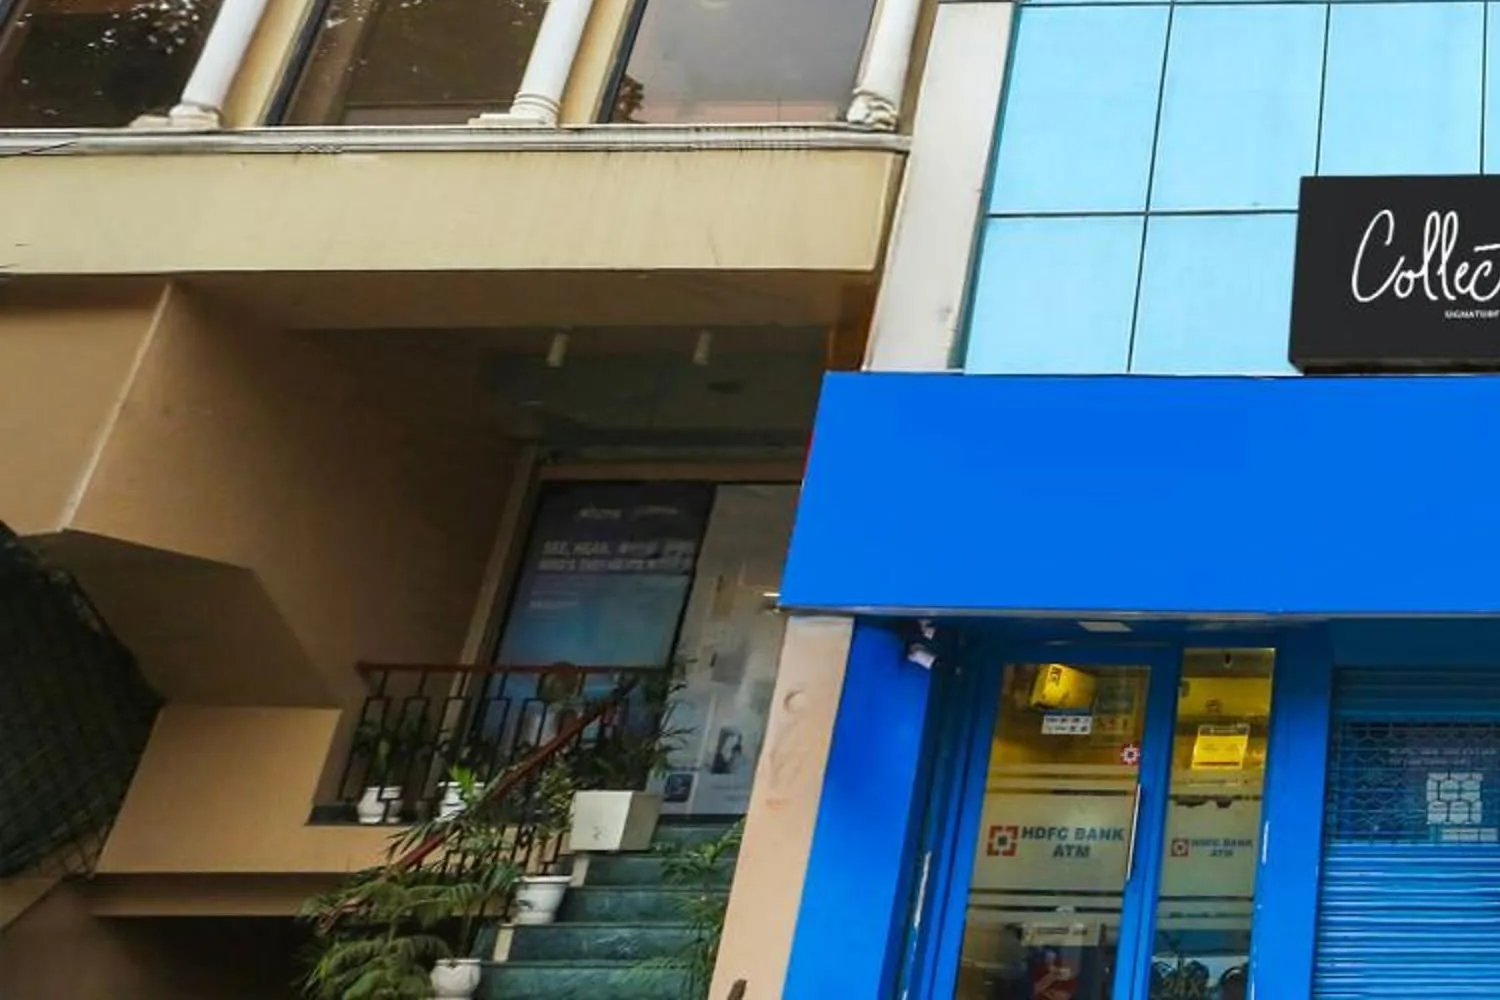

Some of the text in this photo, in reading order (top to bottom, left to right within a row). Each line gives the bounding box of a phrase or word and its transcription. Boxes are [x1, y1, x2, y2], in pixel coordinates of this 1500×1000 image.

[1021, 826, 1125, 841] HDFC BANK
[1053, 844, 1091, 858] ATM
